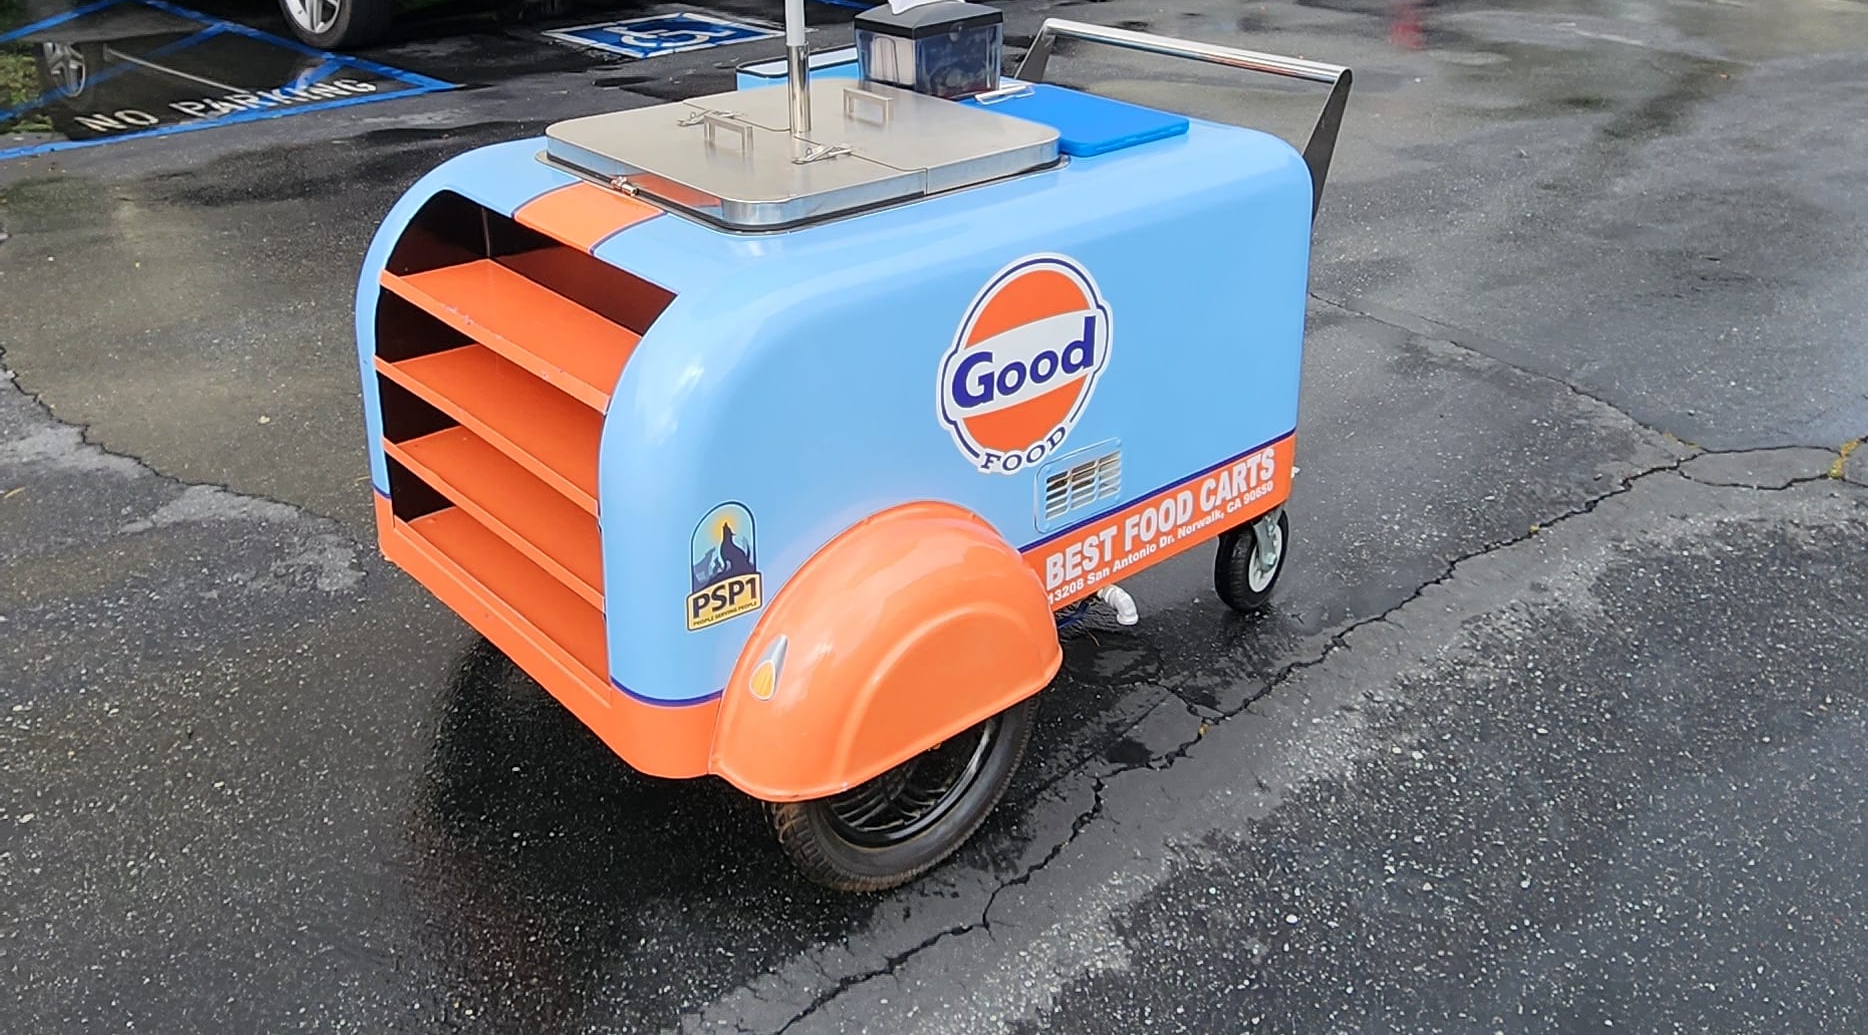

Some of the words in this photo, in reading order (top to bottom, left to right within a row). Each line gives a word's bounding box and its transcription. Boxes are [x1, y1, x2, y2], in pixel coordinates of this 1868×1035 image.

[74, 109, 159, 132] NO
[169, 79, 377, 118] PARKING
[951, 315, 1097, 409] Good
[981, 426, 1067, 472] FOOD
[1046, 526, 1118, 591] BEST
[1124, 490, 1193, 552] FOOD
[1200, 448, 1275, 512] CARTS
[1047, 578, 1084, 605] 13208
[1087, 567, 1110, 585] San
[1113, 543, 1157, 572] Antonio
[1159, 535, 1175, 549] Dr.
[1177, 509, 1225, 539] Norwalk,
[1226, 497, 1242, 513] CA
[1243, 480, 1274, 504] 90650
[692, 577, 757, 620] PSP1
